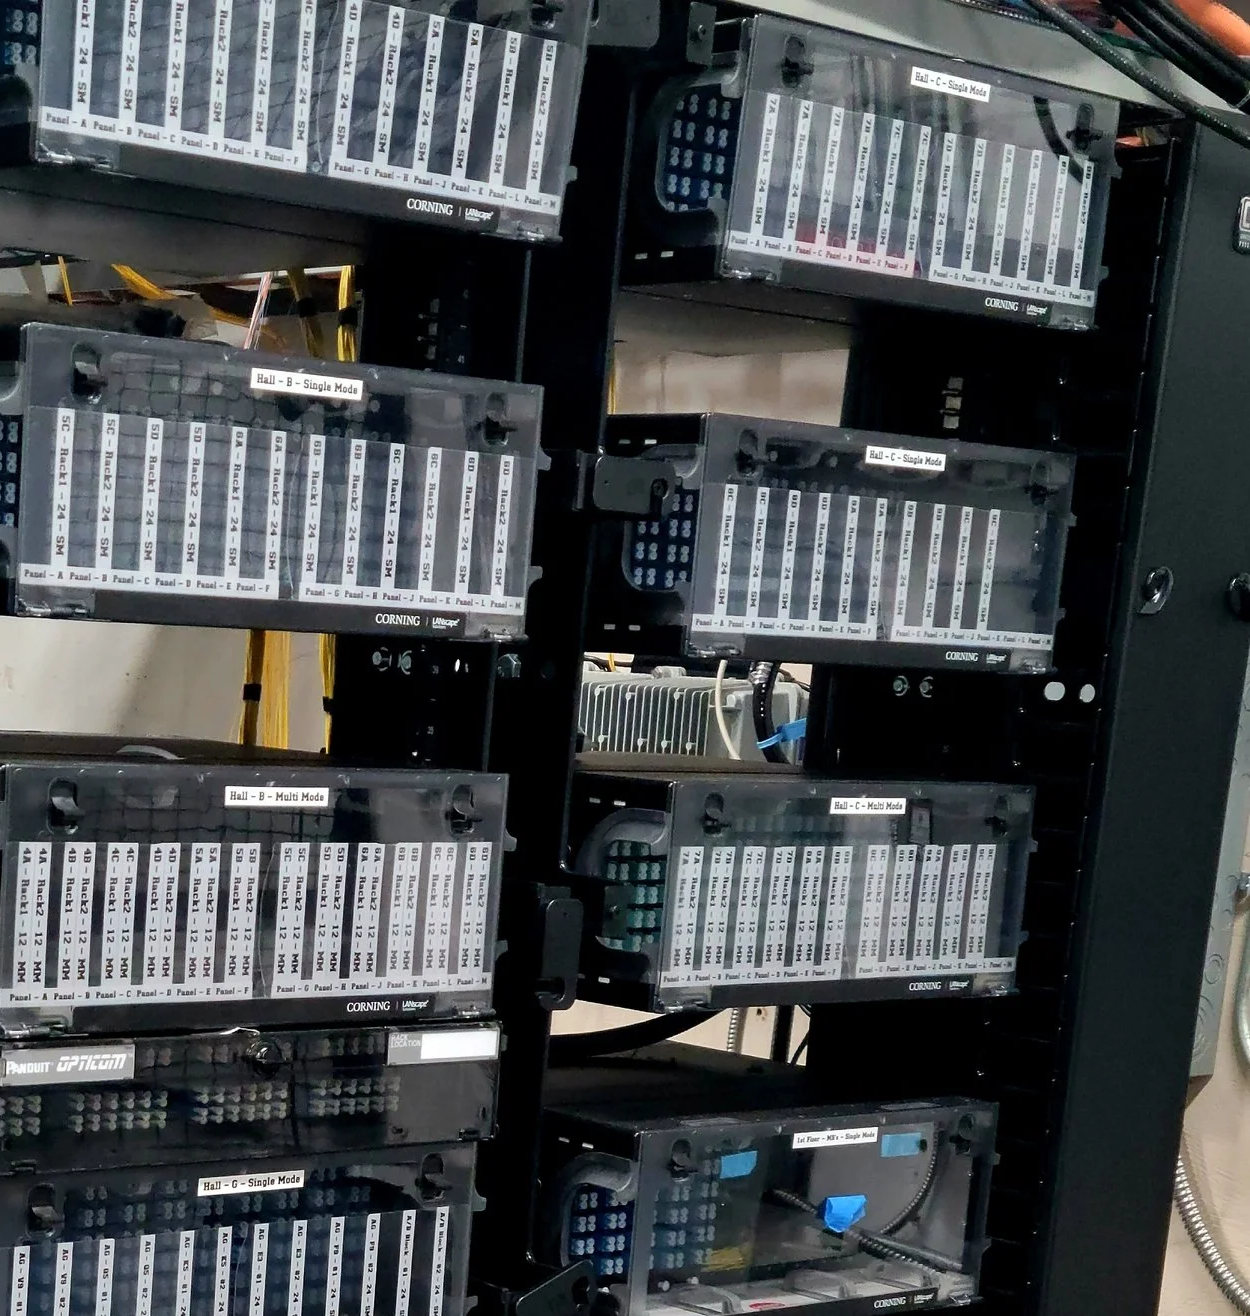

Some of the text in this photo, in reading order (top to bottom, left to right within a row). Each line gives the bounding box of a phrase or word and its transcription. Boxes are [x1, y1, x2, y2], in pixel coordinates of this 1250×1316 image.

[914, 70, 986, 97] Hall C Single Mode
[984, 296, 1019, 311] CORNING
[256, 372, 358, 395] Hall B Single Mode
[868, 449, 942, 466] Hall C Single Mode
[384, 448, 401, 578] 6C Rack1 24 SM
[23, 568, 63, 579] Panel A
[374, 612, 420, 626] CORNING
[229, 790, 324, 801] Hall B Multi Mode
[833, 800, 902, 810] Hall C Multi Mode
[16, 846, 32, 983] 4A Rack1 12 MM
[908, 980, 942, 991] CORNING
[346, 1000, 390, 1012] CORNING
[202, 1173, 300, 1191] Hall G Single Mode
